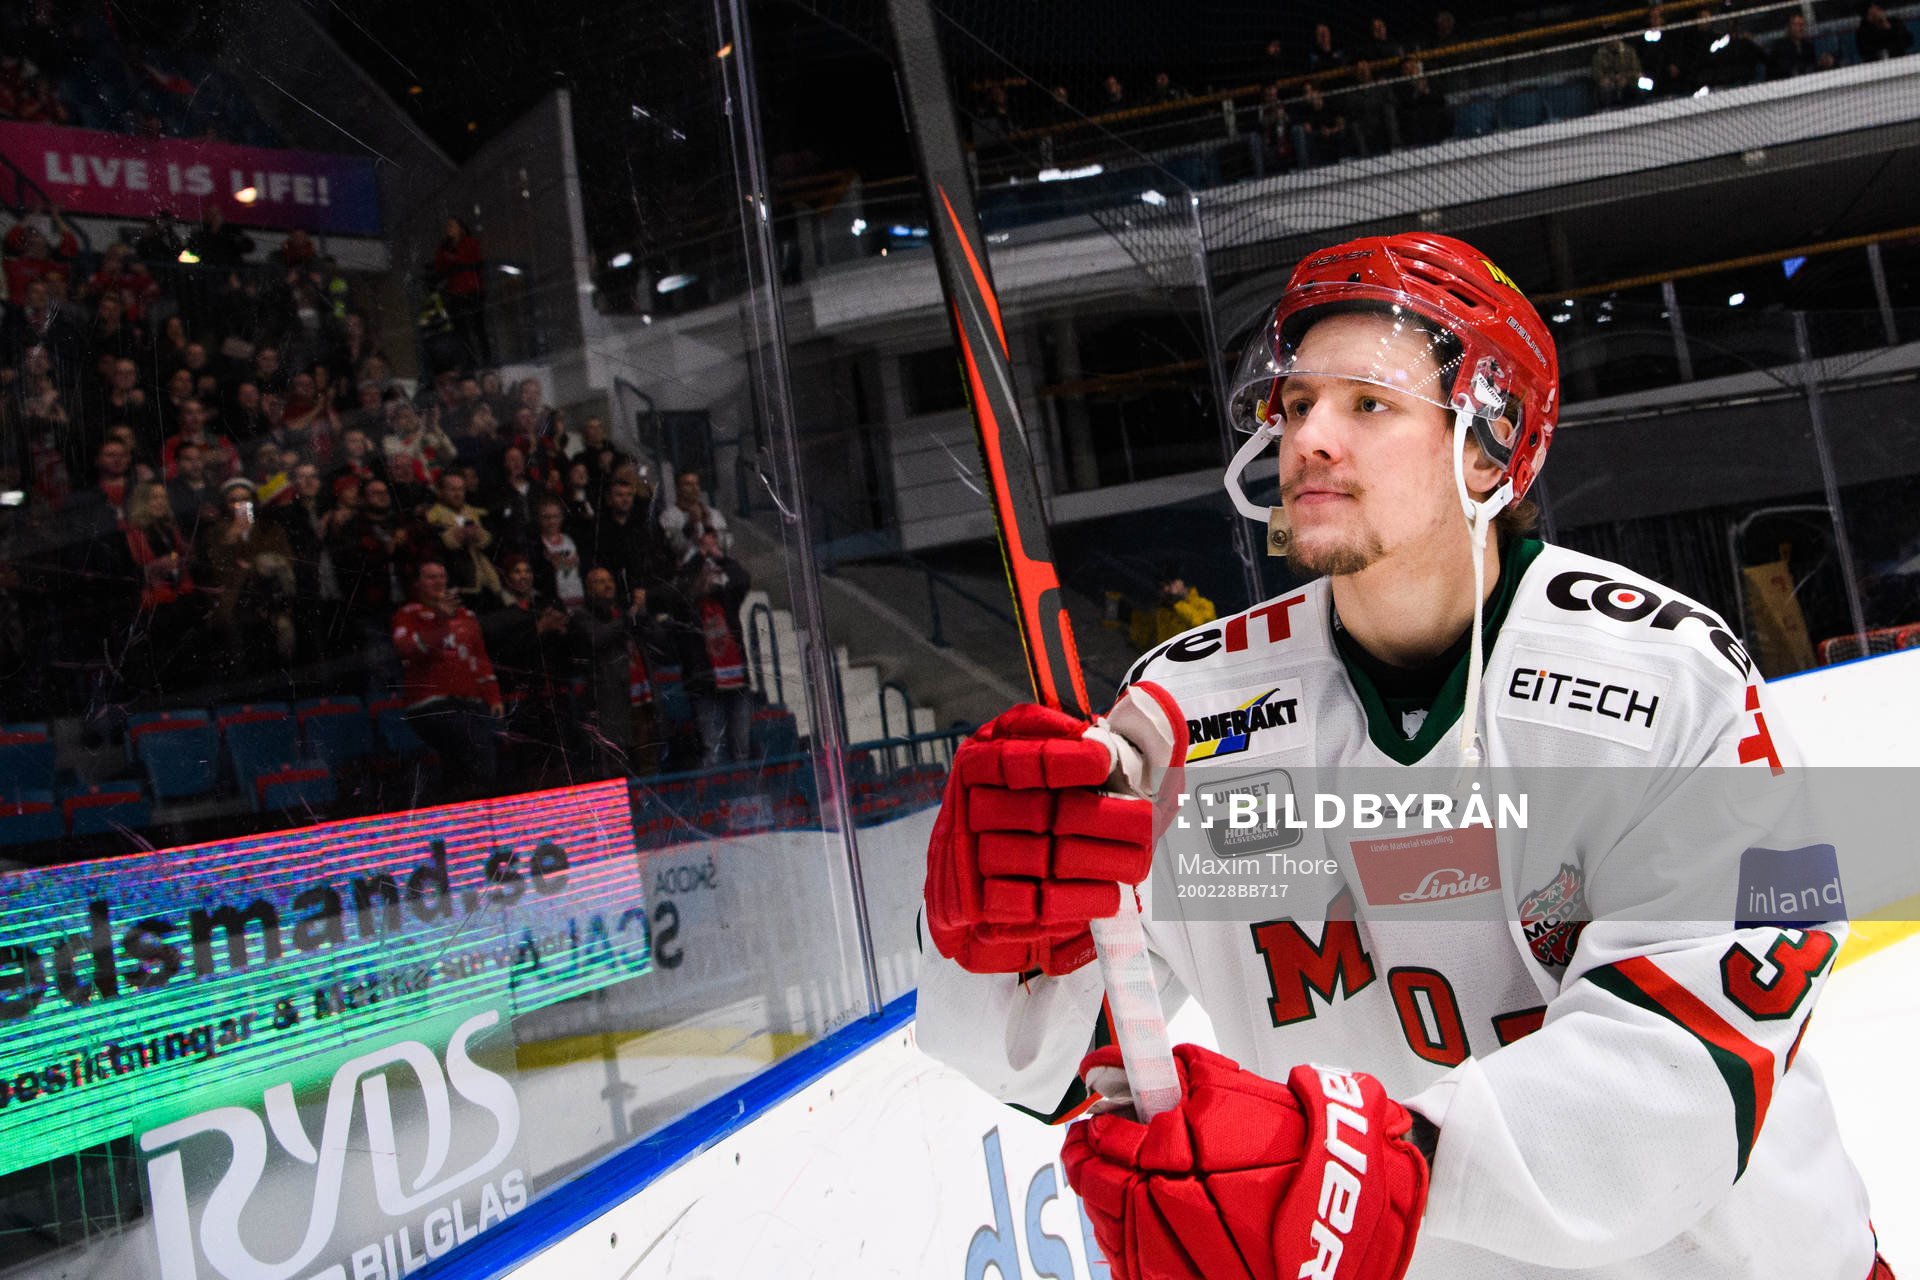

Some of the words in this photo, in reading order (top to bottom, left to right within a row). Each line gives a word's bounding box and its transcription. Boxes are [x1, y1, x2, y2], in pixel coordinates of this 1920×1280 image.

[45, 152, 150, 191] LIVE
[167, 163, 215, 196] IS
[230, 169, 331, 206] LIFE!
[1390, 840, 1420, 851] Material
[1420, 835, 1454, 847] Handling
[1398, 868, 1492, 900] Linde
[1749, 877, 1842, 915] inland
[352, 1168, 527, 1280] BILGLAS
